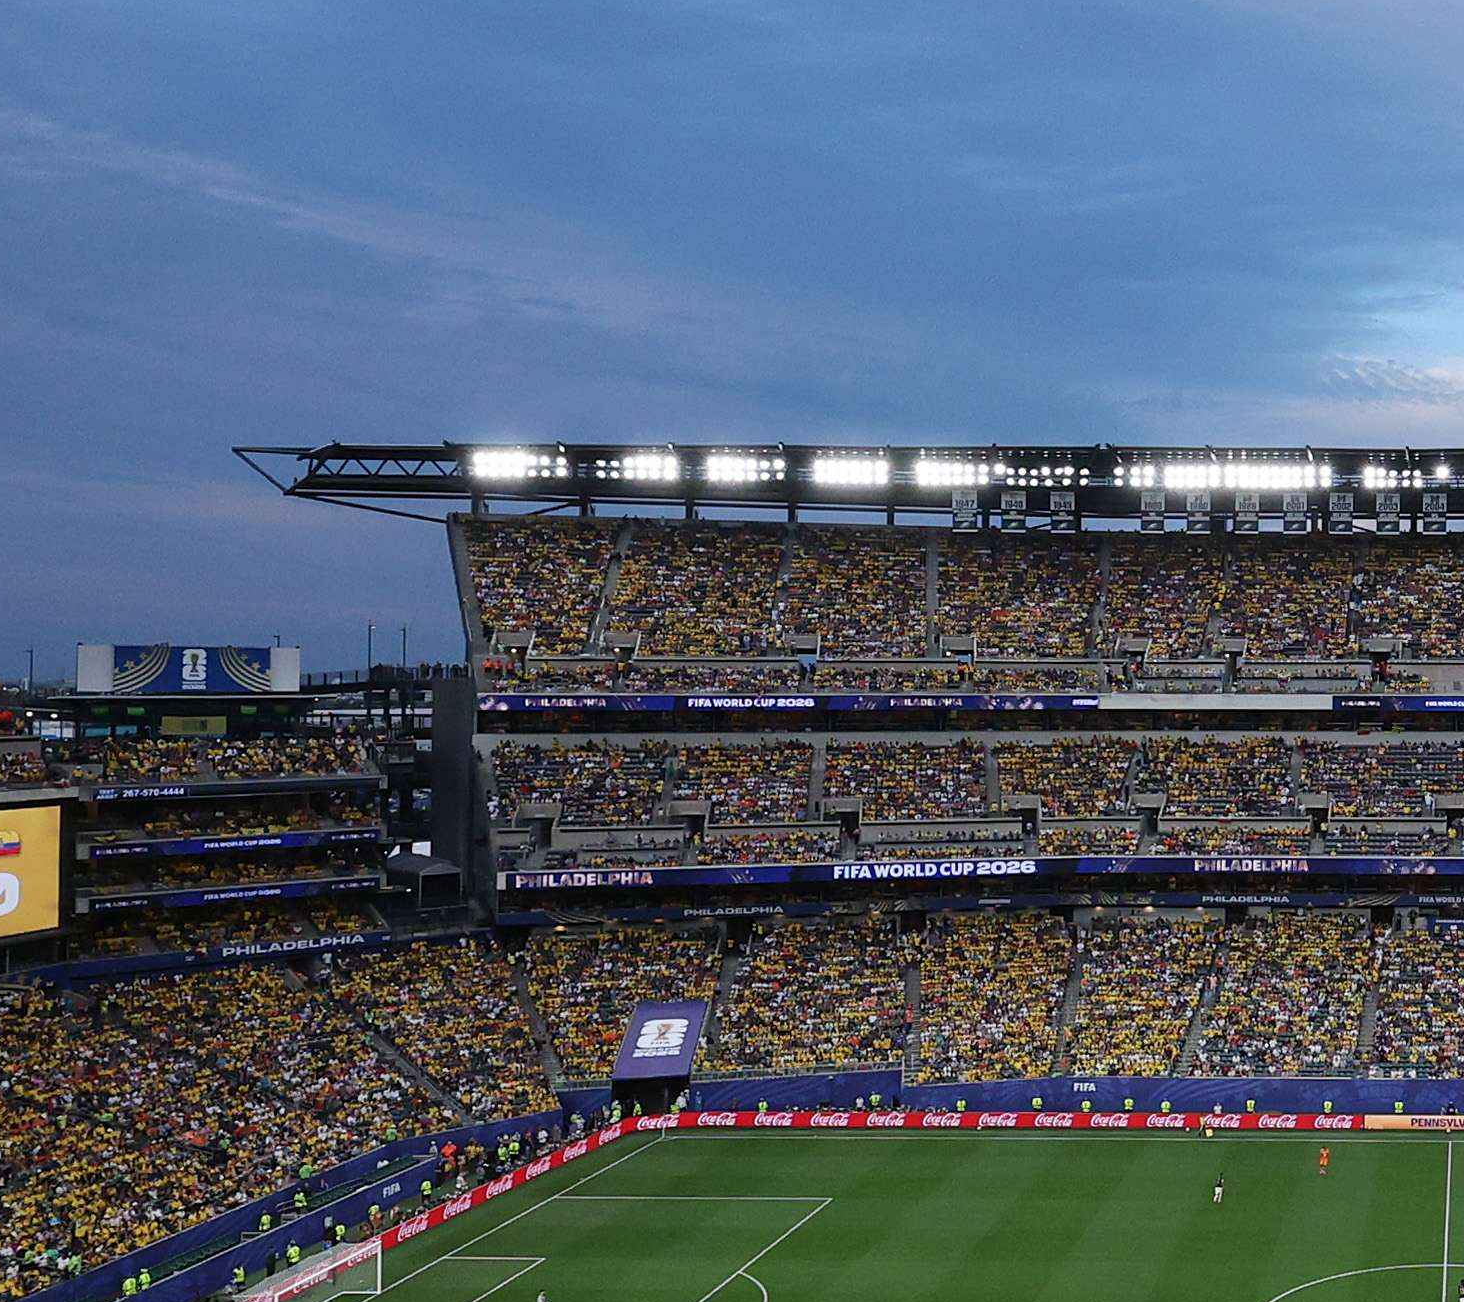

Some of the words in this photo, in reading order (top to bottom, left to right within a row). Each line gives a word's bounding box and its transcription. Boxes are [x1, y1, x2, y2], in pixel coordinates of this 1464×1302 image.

[688, 699, 712, 707] FIFA
[713, 698, 753, 707] WORLD
[753, 698, 776, 707] CUP
[777, 698, 815, 707] 2026
[833, 865, 872, 879] FIFA
[873, 863, 937, 879] WORLD
[939, 862, 974, 877] CUP
[976, 860, 1036, 876] 2026
[1194, 860, 1309, 872] PHILADELPHIA
[516, 871, 653, 888] PHILADELPHIA
[1202, 895, 1290, 903] PHILADELPHIA
[683, 905, 785, 916] PHILADELPHIA
[221, 935, 365, 957] PHILADELPHIA
[1073, 1082, 1096, 1092] FIFA
[598, 1125, 623, 1145] Coca-Cola
[562, 1139, 589, 1162] Coca-Cola
[525, 1156, 551, 1180] Coca-Cola
[382, 1182, 402, 1199] FIFA
[485, 1174, 515, 1199] Coca-Cola
[443, 1193, 472, 1219] Coca-Cola
[397, 1213, 429, 1242] Coca-Cola
